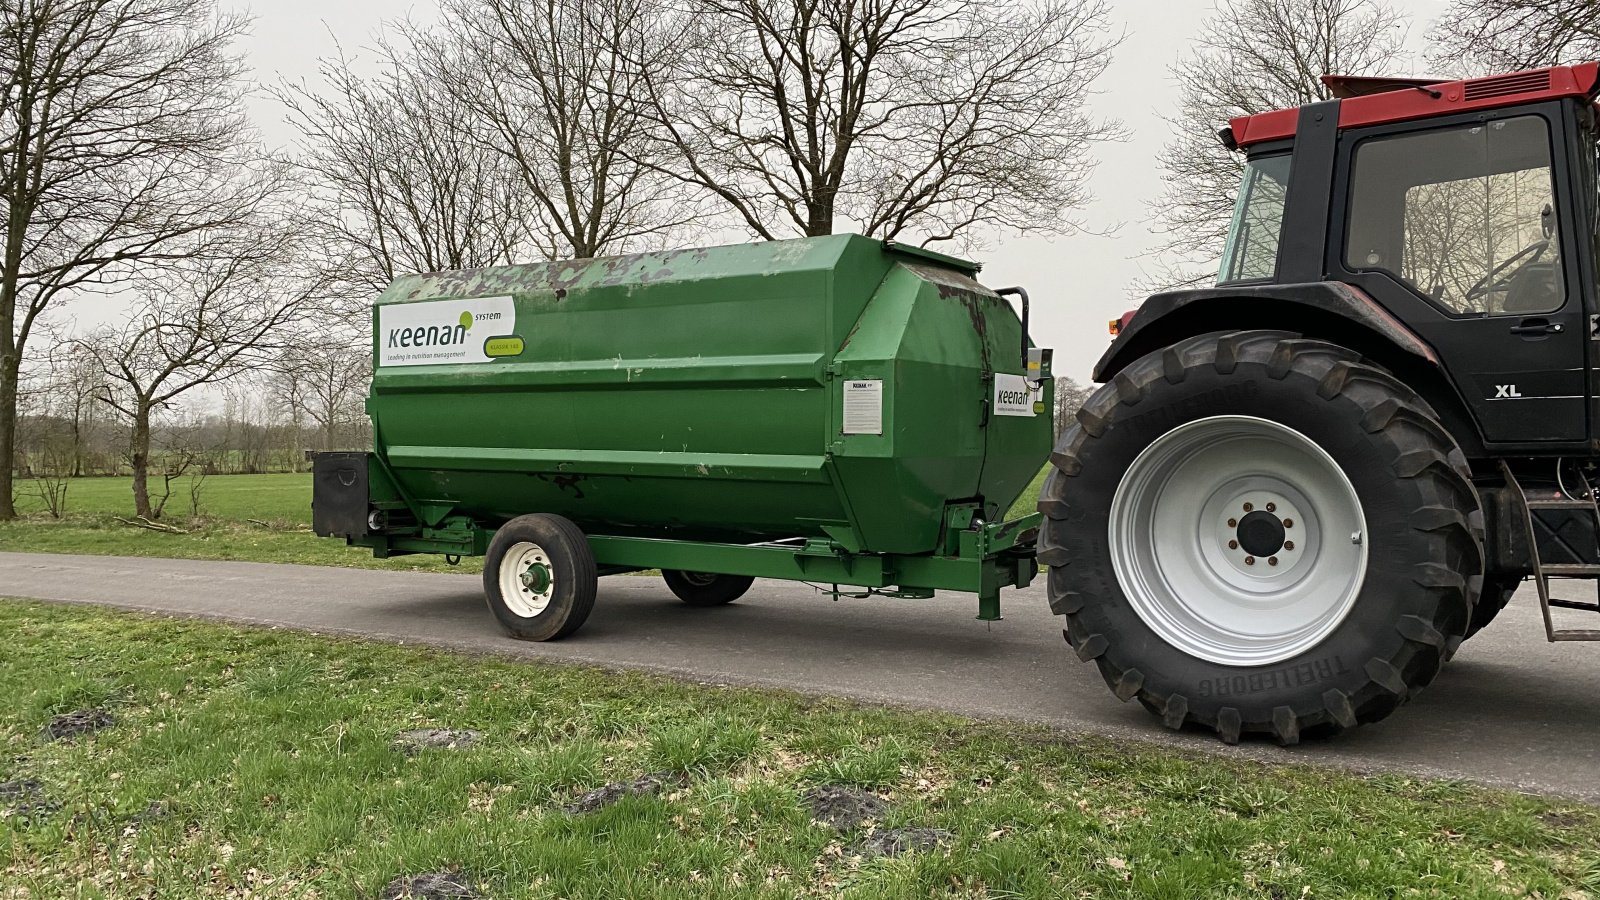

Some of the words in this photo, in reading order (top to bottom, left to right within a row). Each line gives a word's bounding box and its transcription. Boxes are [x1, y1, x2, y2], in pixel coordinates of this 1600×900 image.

[387, 354, 405, 362] Leading
[412, 352, 433, 360] nutrition
[433, 351, 466, 360] management
[1495, 384, 1522, 398] XL
[1199, 655, 1351, 697] TRELLEBORG
